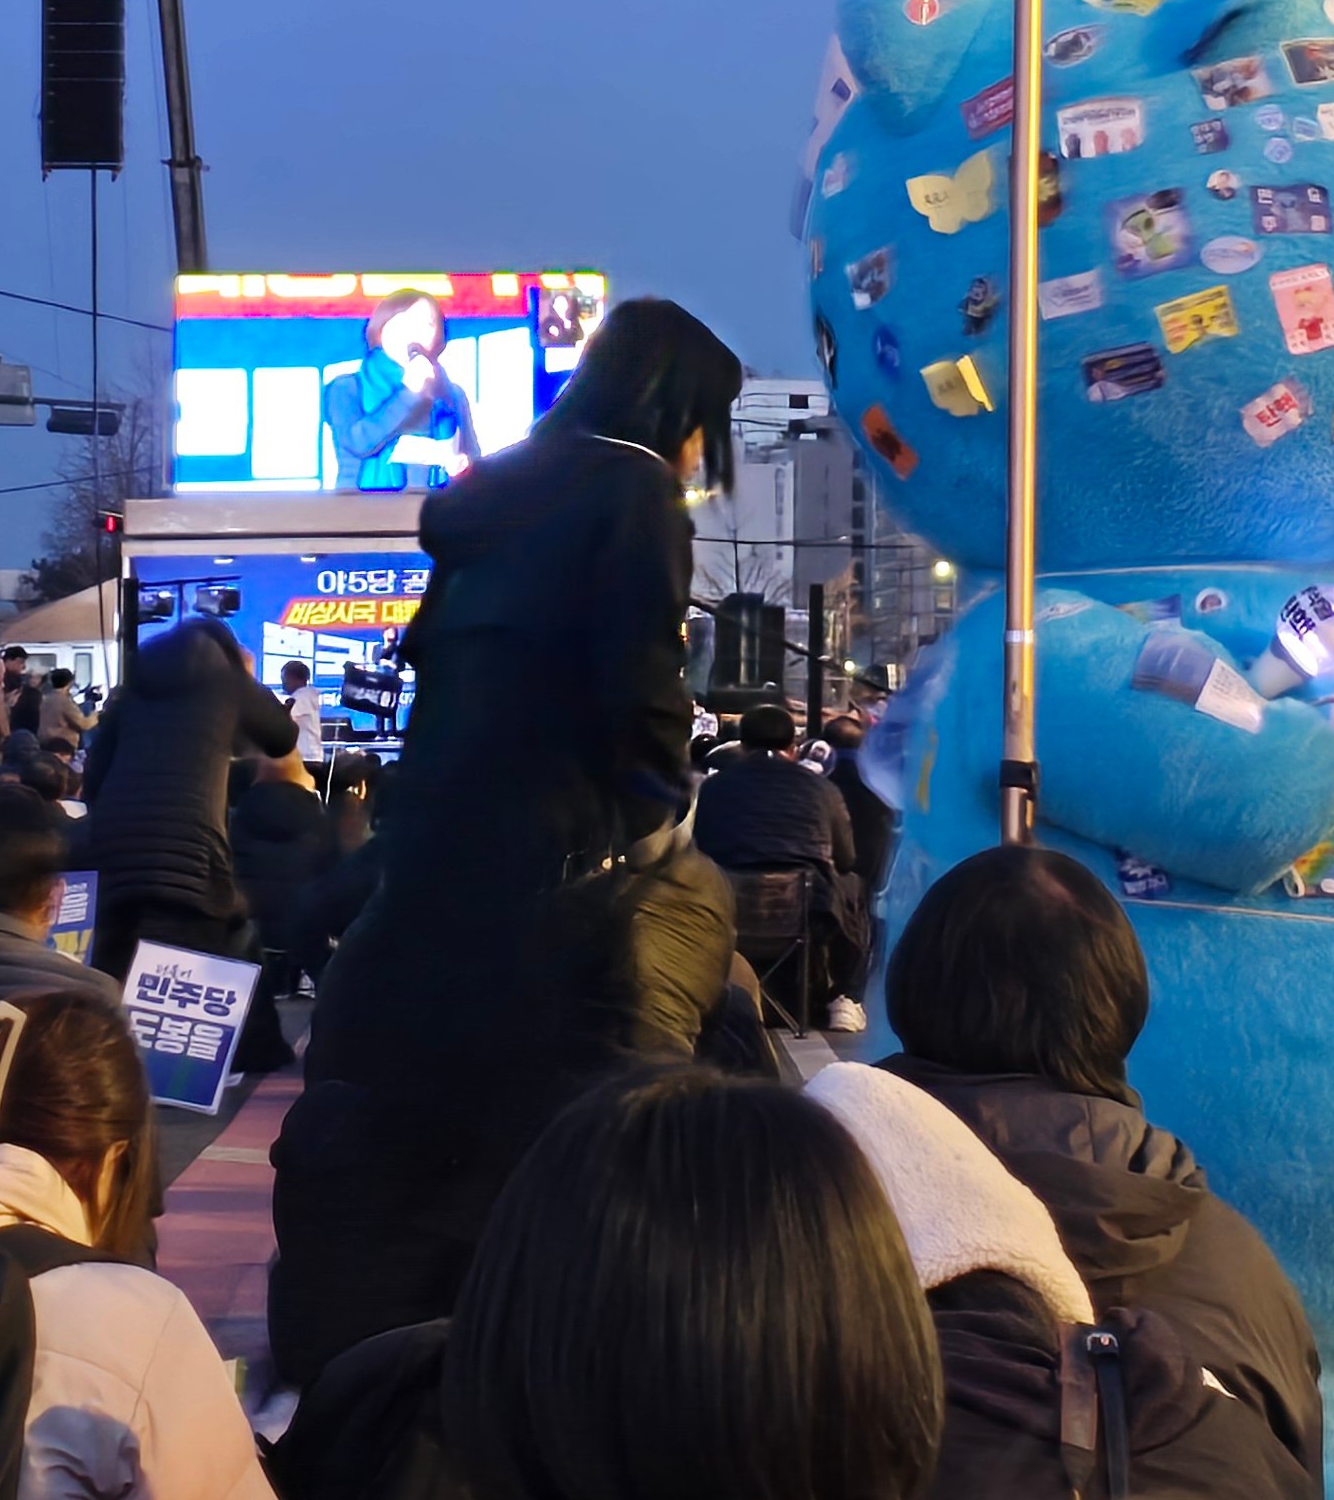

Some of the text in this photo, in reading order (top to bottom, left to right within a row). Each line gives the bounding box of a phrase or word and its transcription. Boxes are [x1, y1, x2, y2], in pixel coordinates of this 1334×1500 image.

[317, 569, 397, 595] 야5당
[284, 599, 377, 625] 비상시국
[136, 972, 237, 1017] 민주당
[130, 1011, 224, 1062] 도봉을
